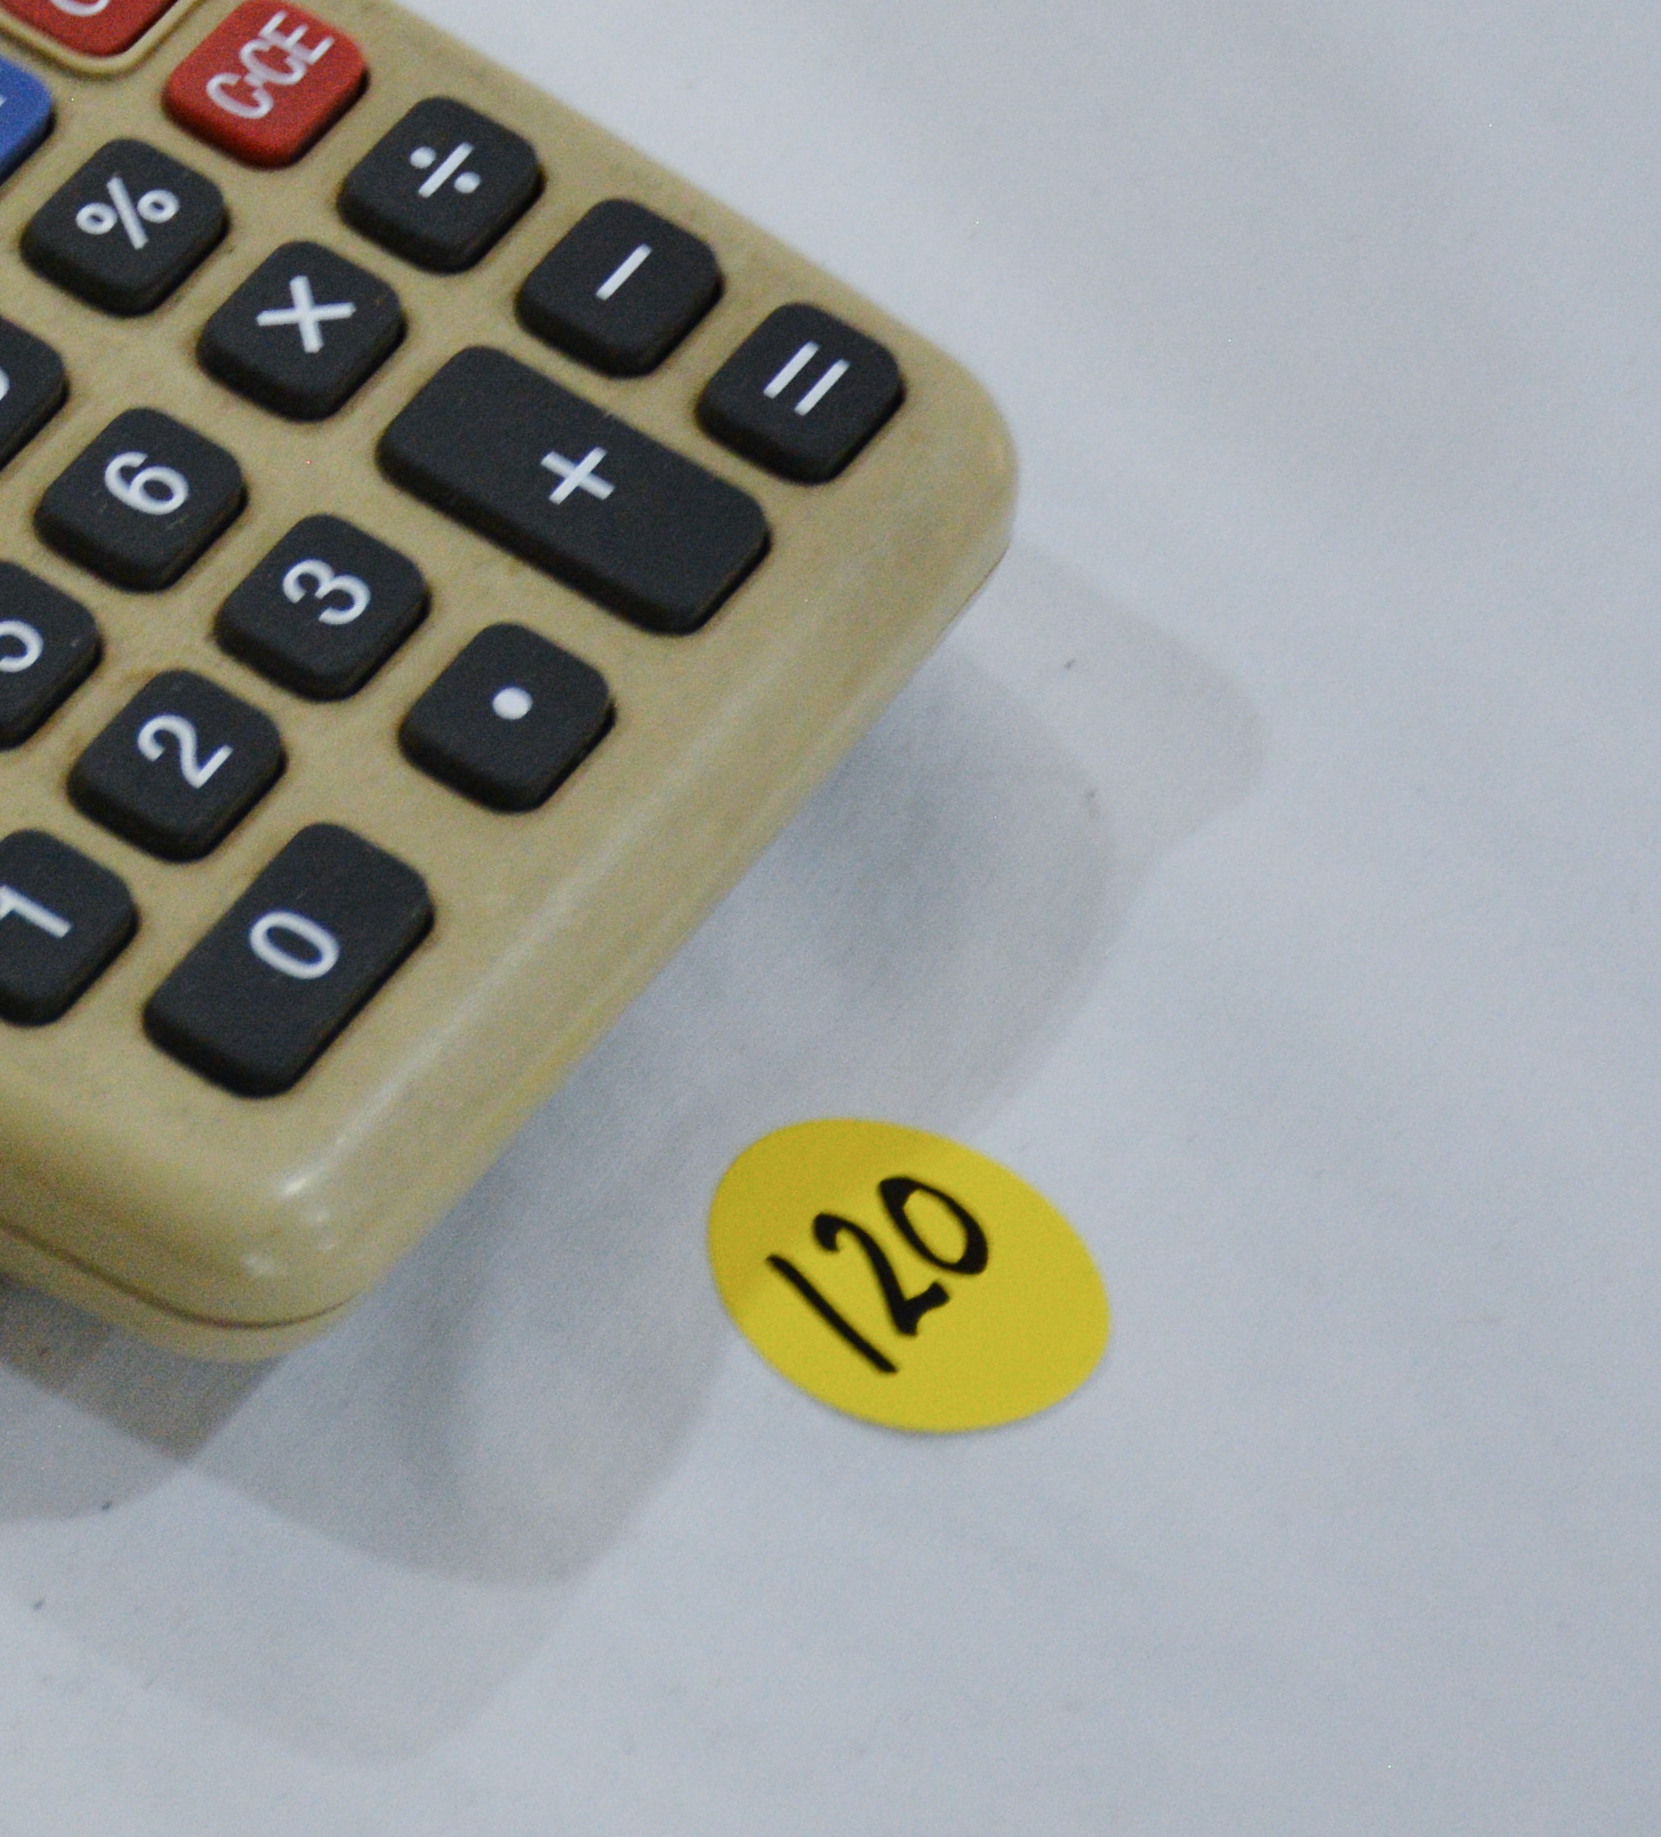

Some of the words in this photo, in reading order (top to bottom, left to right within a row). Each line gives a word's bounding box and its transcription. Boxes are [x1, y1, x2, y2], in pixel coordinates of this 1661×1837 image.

[75, 176, 180, 250] %
[104, 451, 189, 516] 6
[282, 559, 370, 625] 3
[137, 714, 232, 789] 2
[249, 911, 339, 979] 0
[765, 1175, 989, 1375] 120
